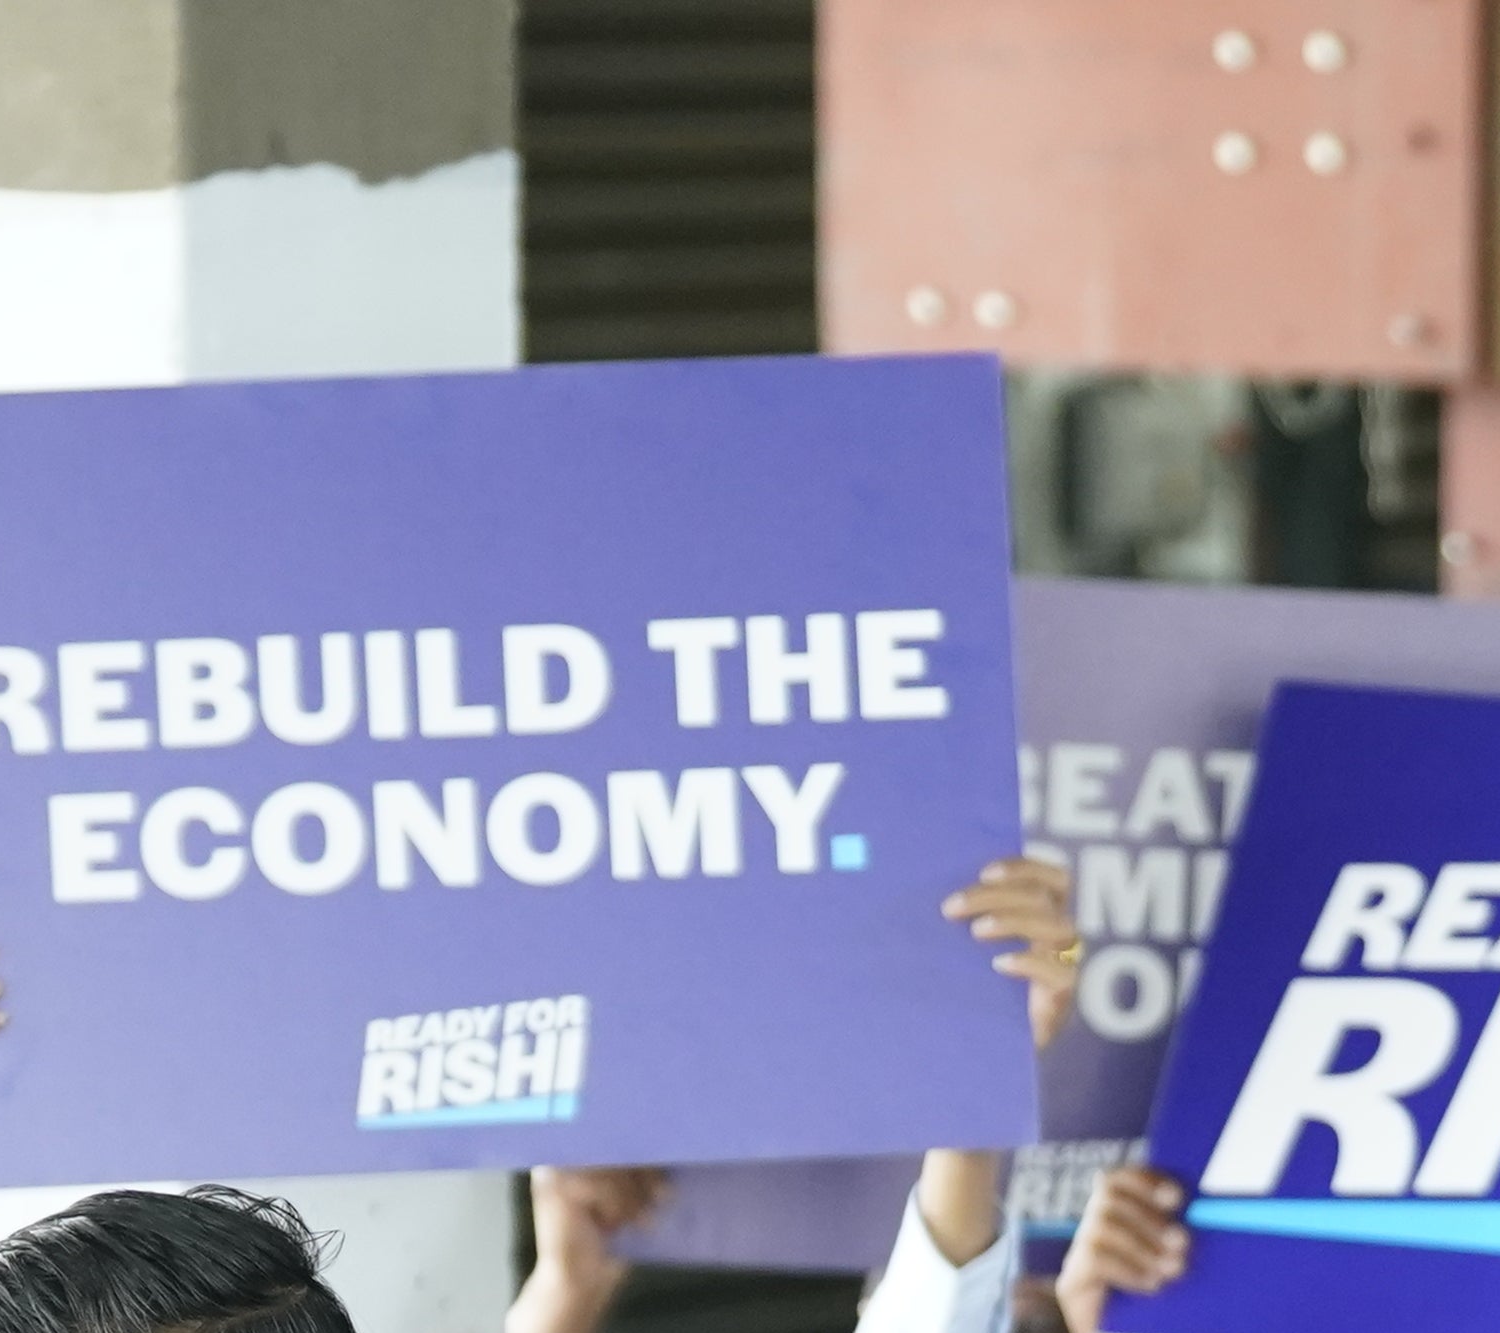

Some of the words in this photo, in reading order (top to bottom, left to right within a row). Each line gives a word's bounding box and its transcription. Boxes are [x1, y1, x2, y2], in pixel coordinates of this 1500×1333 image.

[646, 608, 949, 728] THE
[47, 762, 870, 905] ECONOMY.
[355, 1027, 587, 1118] RISHI
[363, 1003, 501, 1053] READY
[502, 994, 589, 1034] FOR
